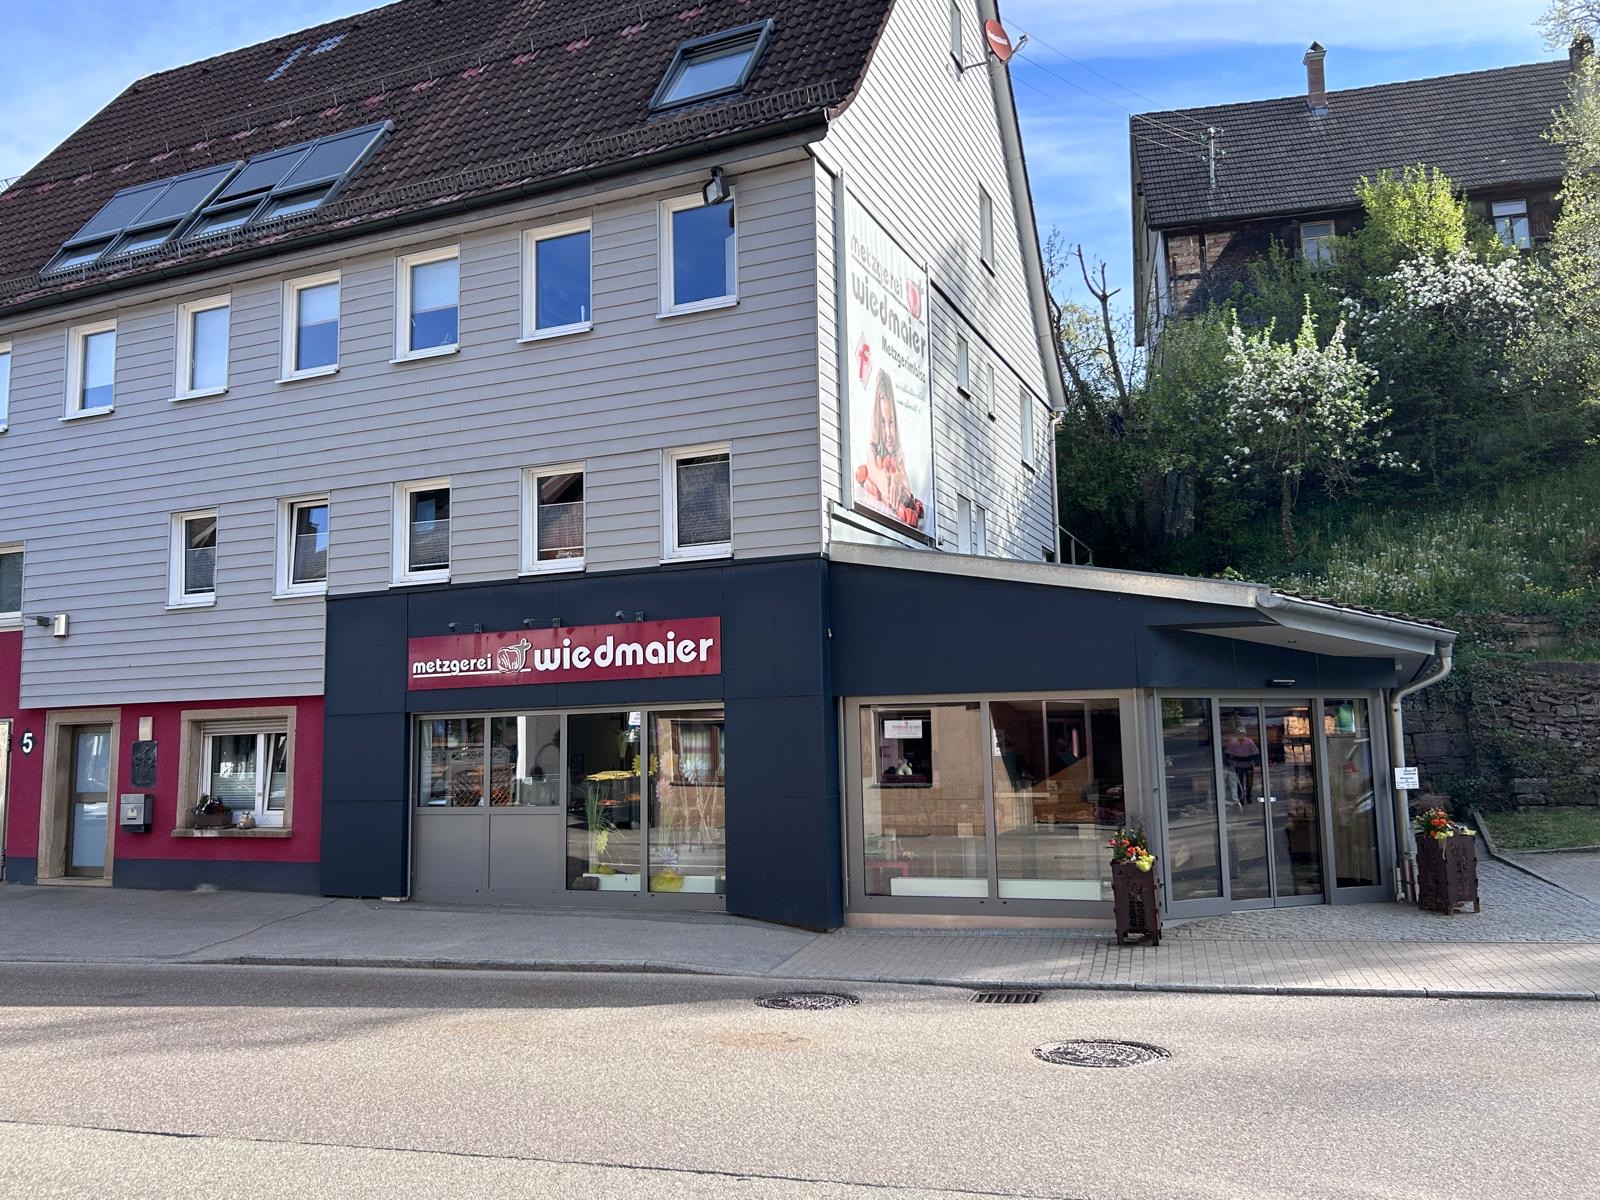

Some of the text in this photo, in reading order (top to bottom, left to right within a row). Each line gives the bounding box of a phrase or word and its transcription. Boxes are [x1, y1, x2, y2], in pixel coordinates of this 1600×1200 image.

[850, 234, 903, 299] metzgerei
[852, 272, 926, 358] wiedmaier
[412, 631, 714, 676] metzgerei wiedmaier
[22, 732, 33, 754] 5
